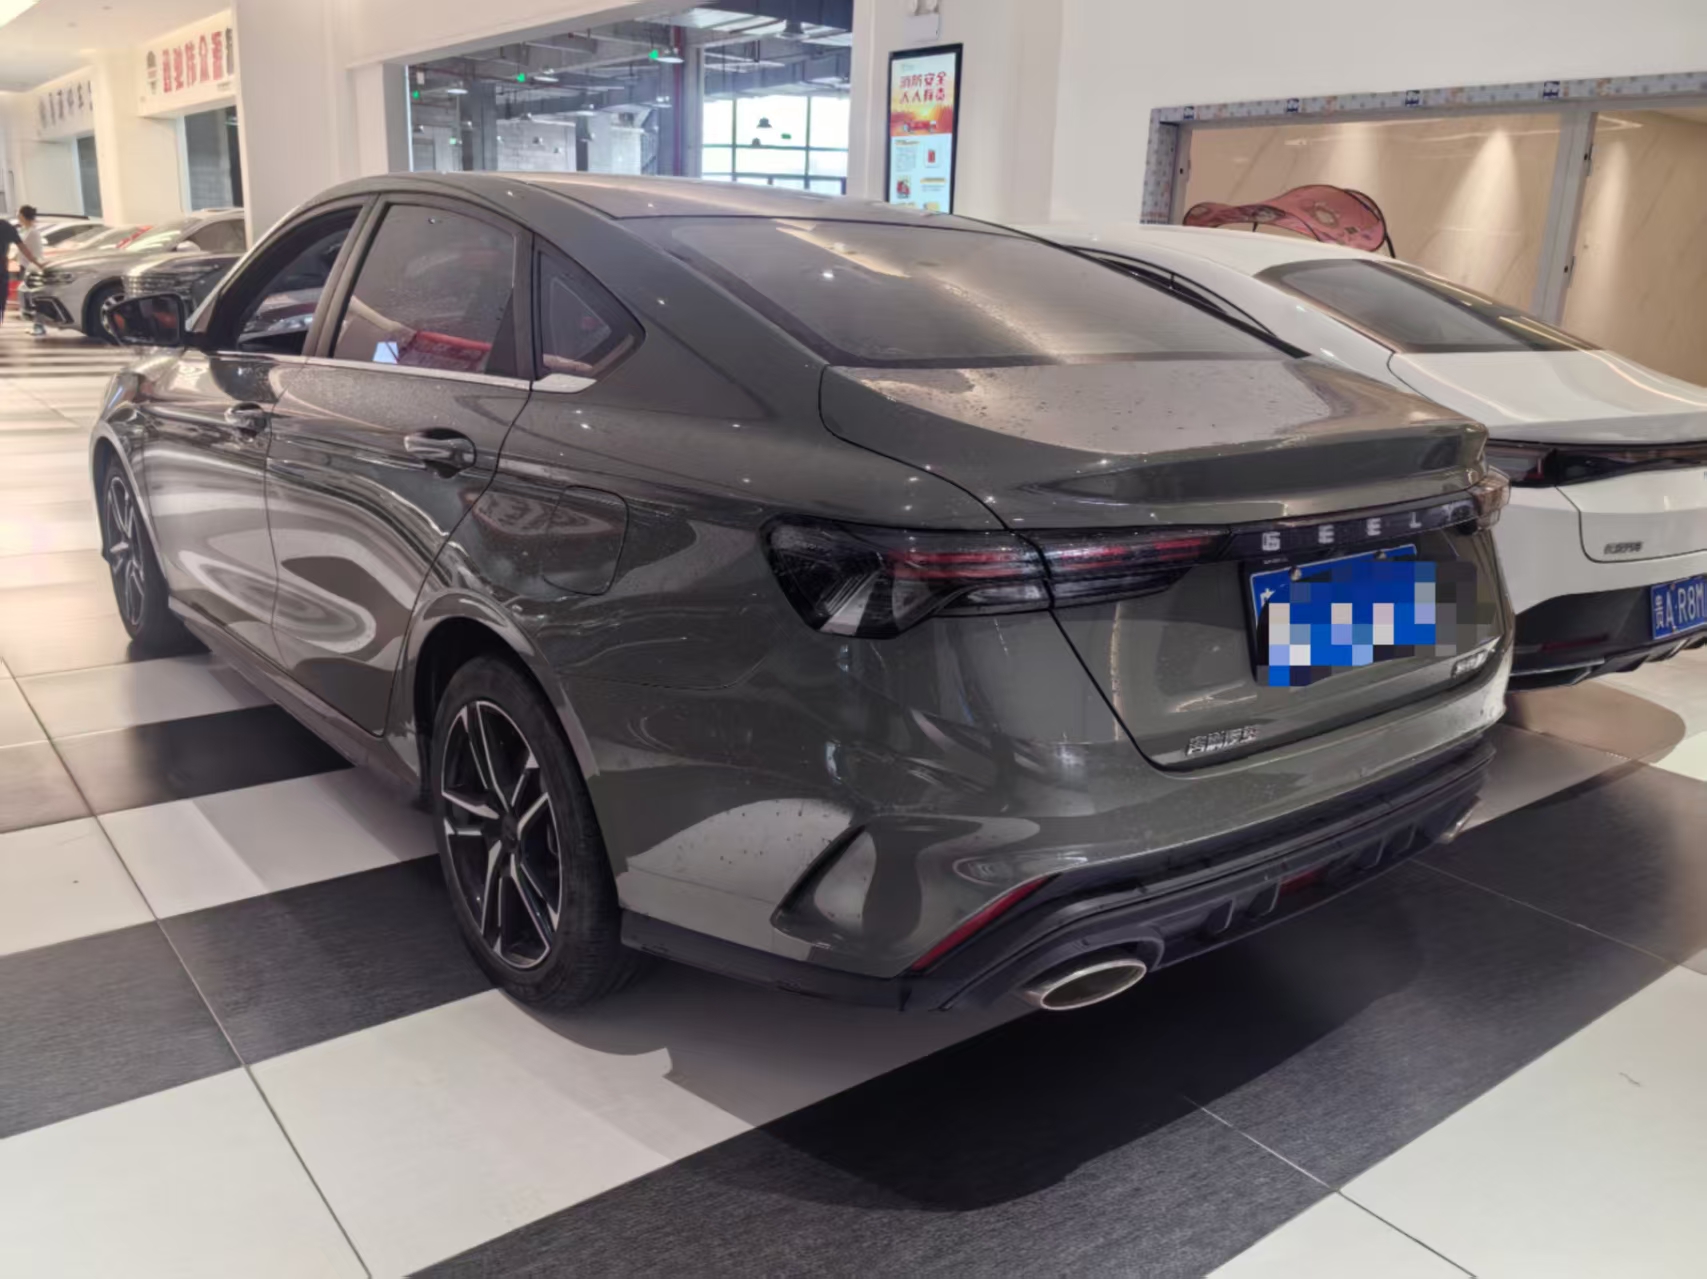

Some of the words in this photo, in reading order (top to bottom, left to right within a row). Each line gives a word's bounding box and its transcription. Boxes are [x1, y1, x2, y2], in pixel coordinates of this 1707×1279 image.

[900, 71, 947, 88] 消防安全
[899, 88, 945, 104] 人人有责
